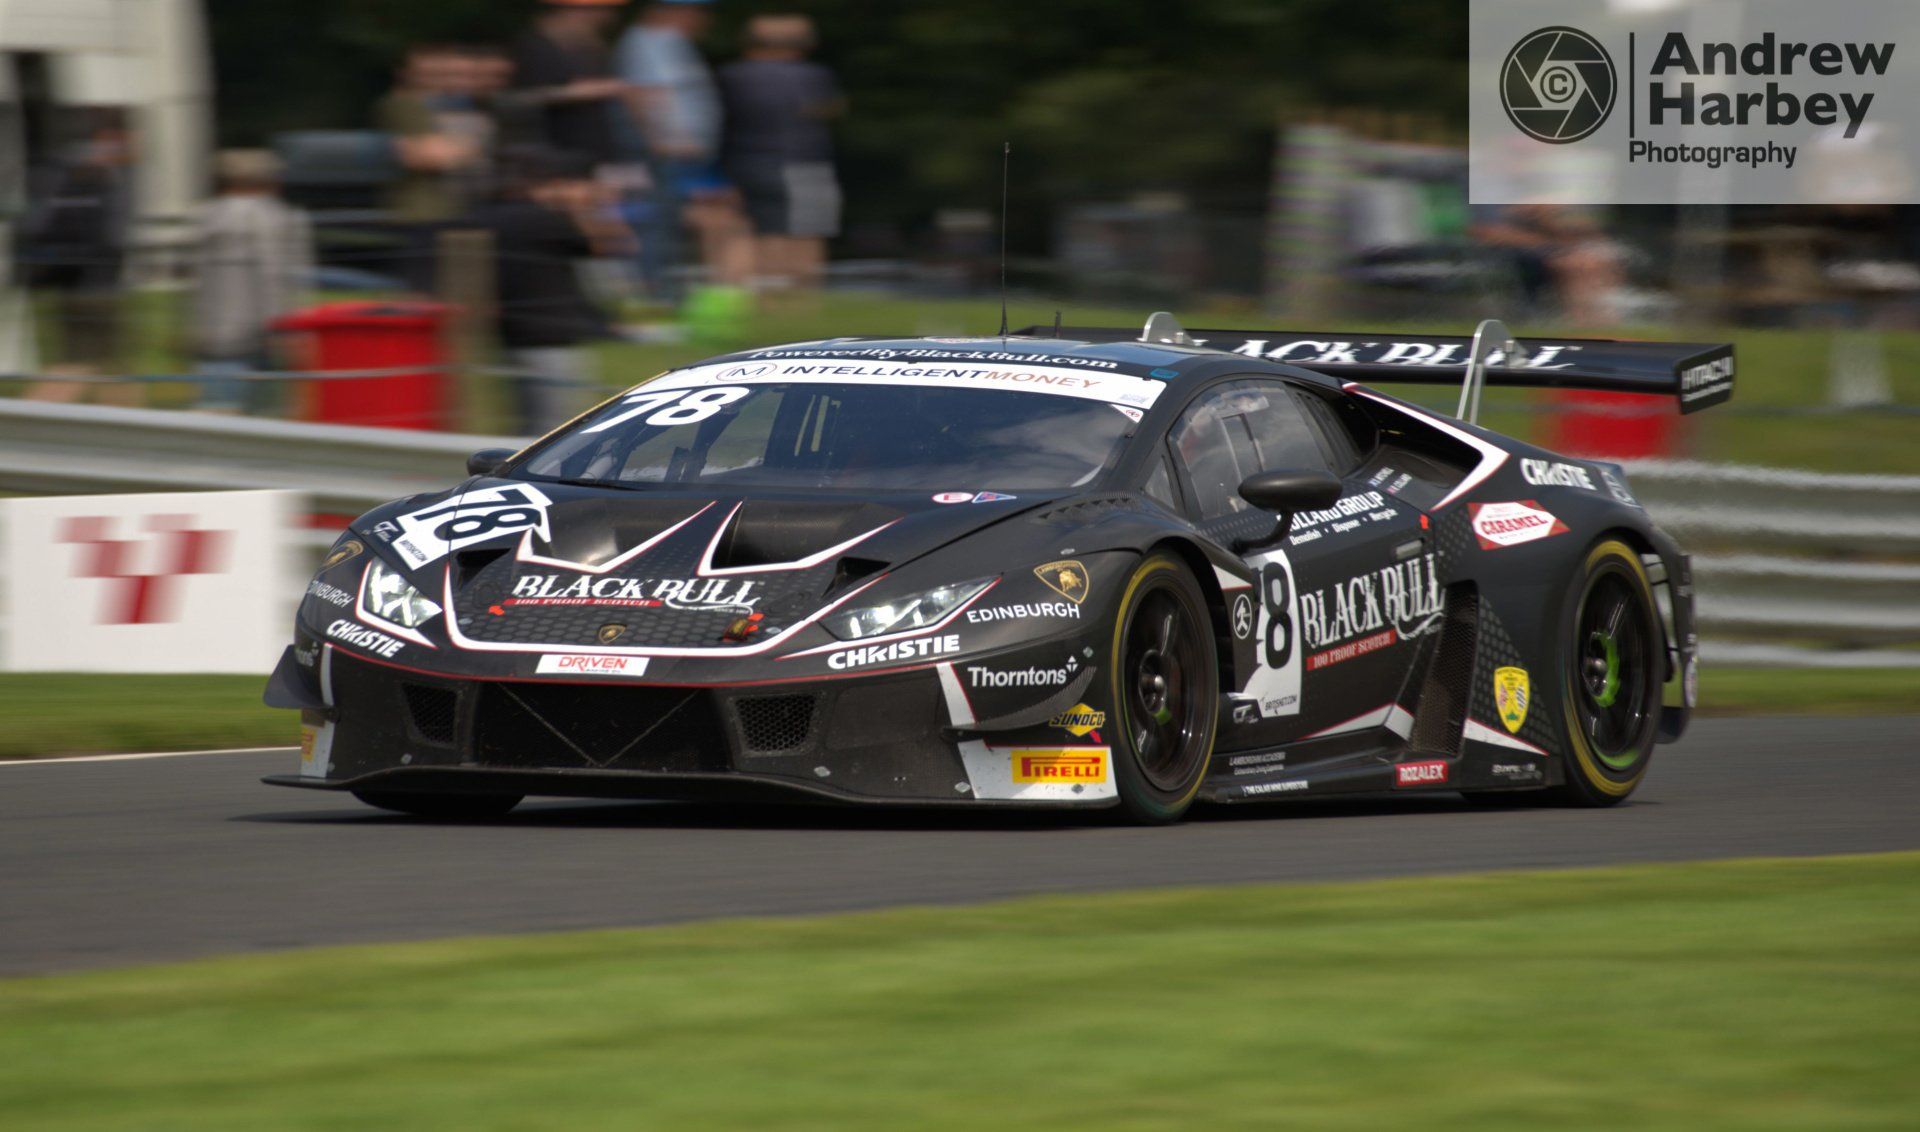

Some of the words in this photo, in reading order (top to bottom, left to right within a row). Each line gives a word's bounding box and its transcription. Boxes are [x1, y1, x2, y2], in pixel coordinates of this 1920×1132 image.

[782, 365, 1102, 389] INTELLIGENTMONEY
[1681, 356, 1734, 390] HITACHI
[579, 386, 751, 434] 78
[1520, 458, 1598, 490] CHRISTIE
[413, 487, 542, 542] 78
[1335, 491, 1385, 516] GROUP
[1480, 514, 1549, 535] CARAMEL
[511, 574, 653, 599] BLACK
[651, 578, 762, 608] BULL
[515, 598, 538, 606] 100
[1300, 571, 1384, 650] BLACK
[1380, 553, 1447, 627] BULL
[966, 602, 1081, 624] EDINBURGH
[325, 618, 406, 659] CHRISTIE
[558, 656, 629, 672] DRIVEN
[827, 633, 961, 670] CHRISTIE
[1313, 656, 1328, 669] 100
[1329, 644, 1357, 664] PROOF
[967, 665, 1067, 688] Thorntons
[1050, 710, 1106, 727] SUNOCO
[1021, 756, 1102, 778] PIRELLI
[1399, 762, 1444, 782] ROZALEX
